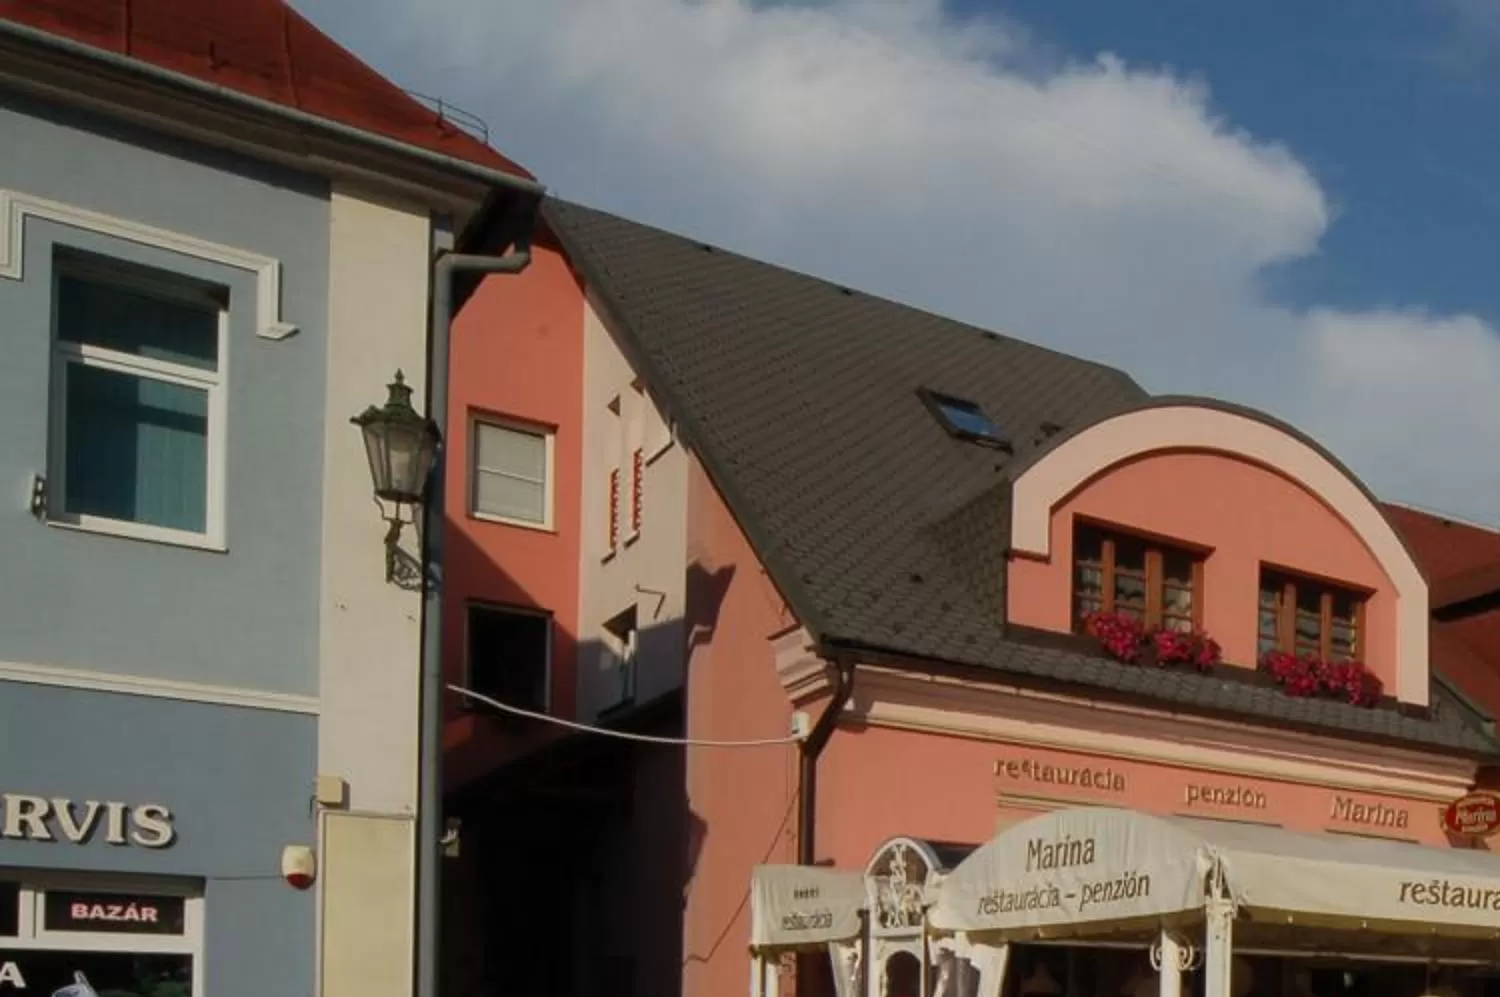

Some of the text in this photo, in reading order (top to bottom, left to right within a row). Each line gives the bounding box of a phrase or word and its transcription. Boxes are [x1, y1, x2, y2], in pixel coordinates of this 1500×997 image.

[2, 793, 174, 847] RVIS
[1331, 795, 1409, 829] Marina
[1025, 834, 1096, 873] Marina
[1078, 870, 1150, 912] penzión
[71, 902, 159, 923] BAZÁR
